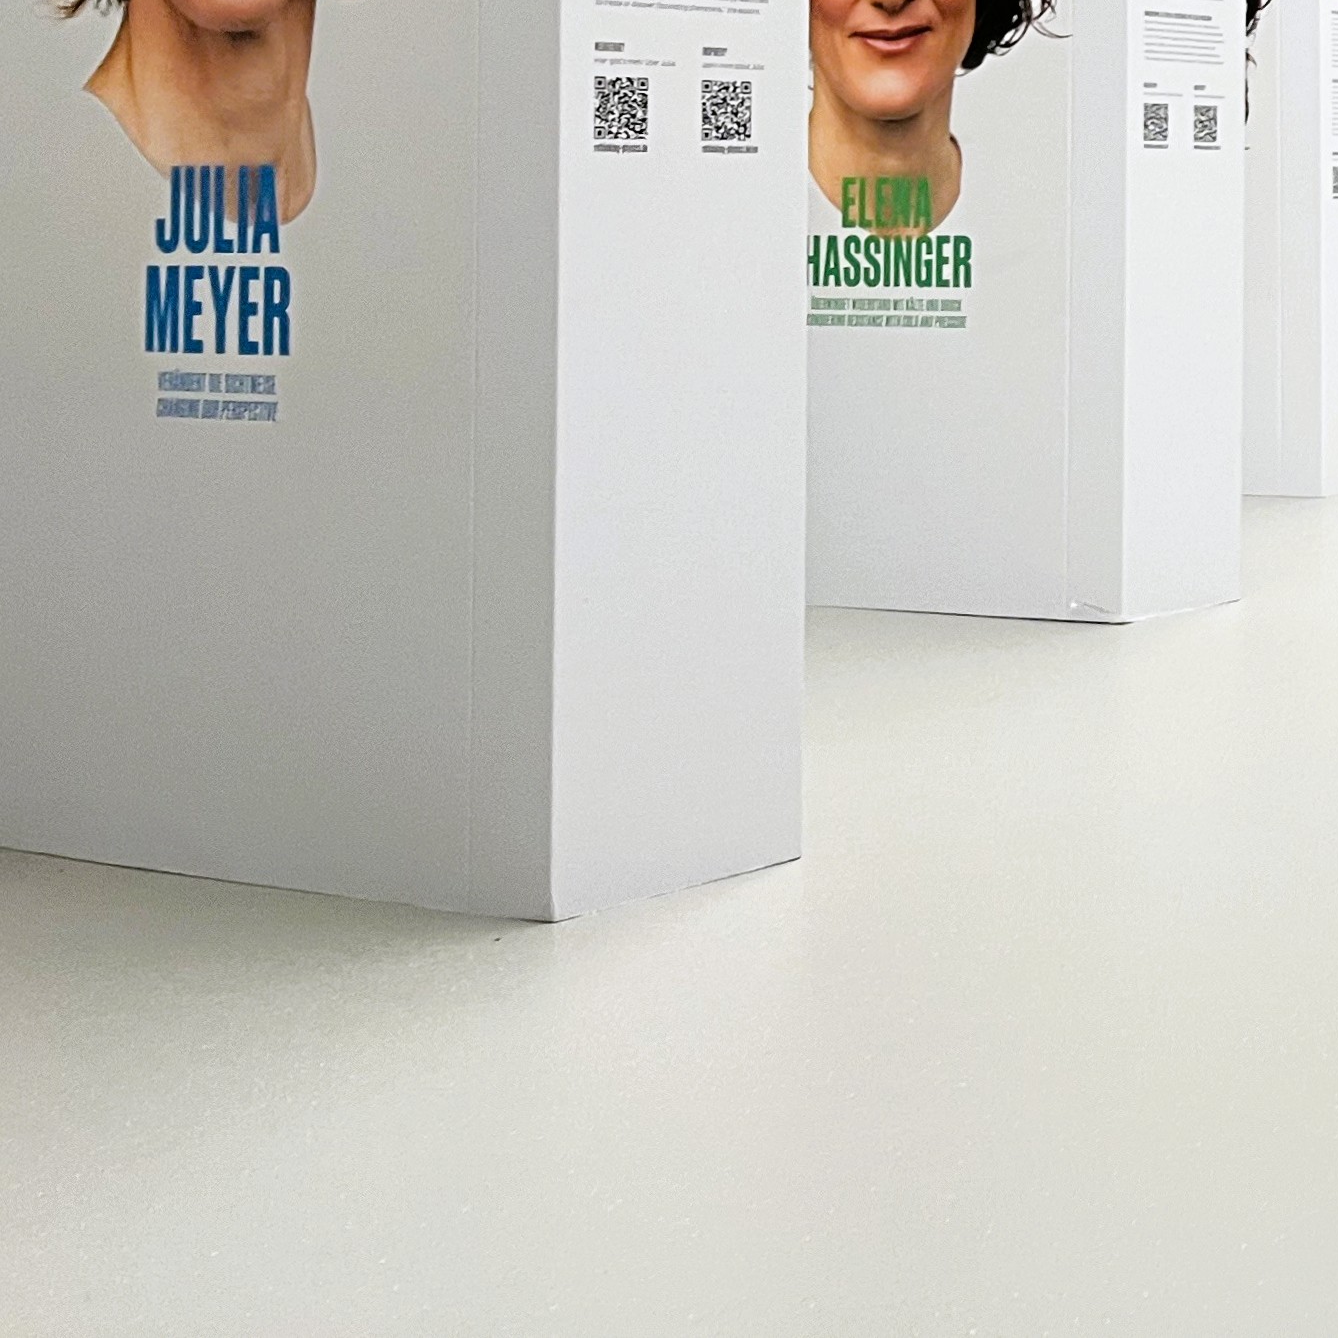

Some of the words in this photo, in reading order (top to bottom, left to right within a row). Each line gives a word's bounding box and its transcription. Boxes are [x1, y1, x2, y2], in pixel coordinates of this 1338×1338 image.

[156, 165, 280, 253] JULIA
[841, 177, 933, 228] ELENA
[807, 235, 972, 288] HASSINGER
[145, 265, 291, 356] MEYER
